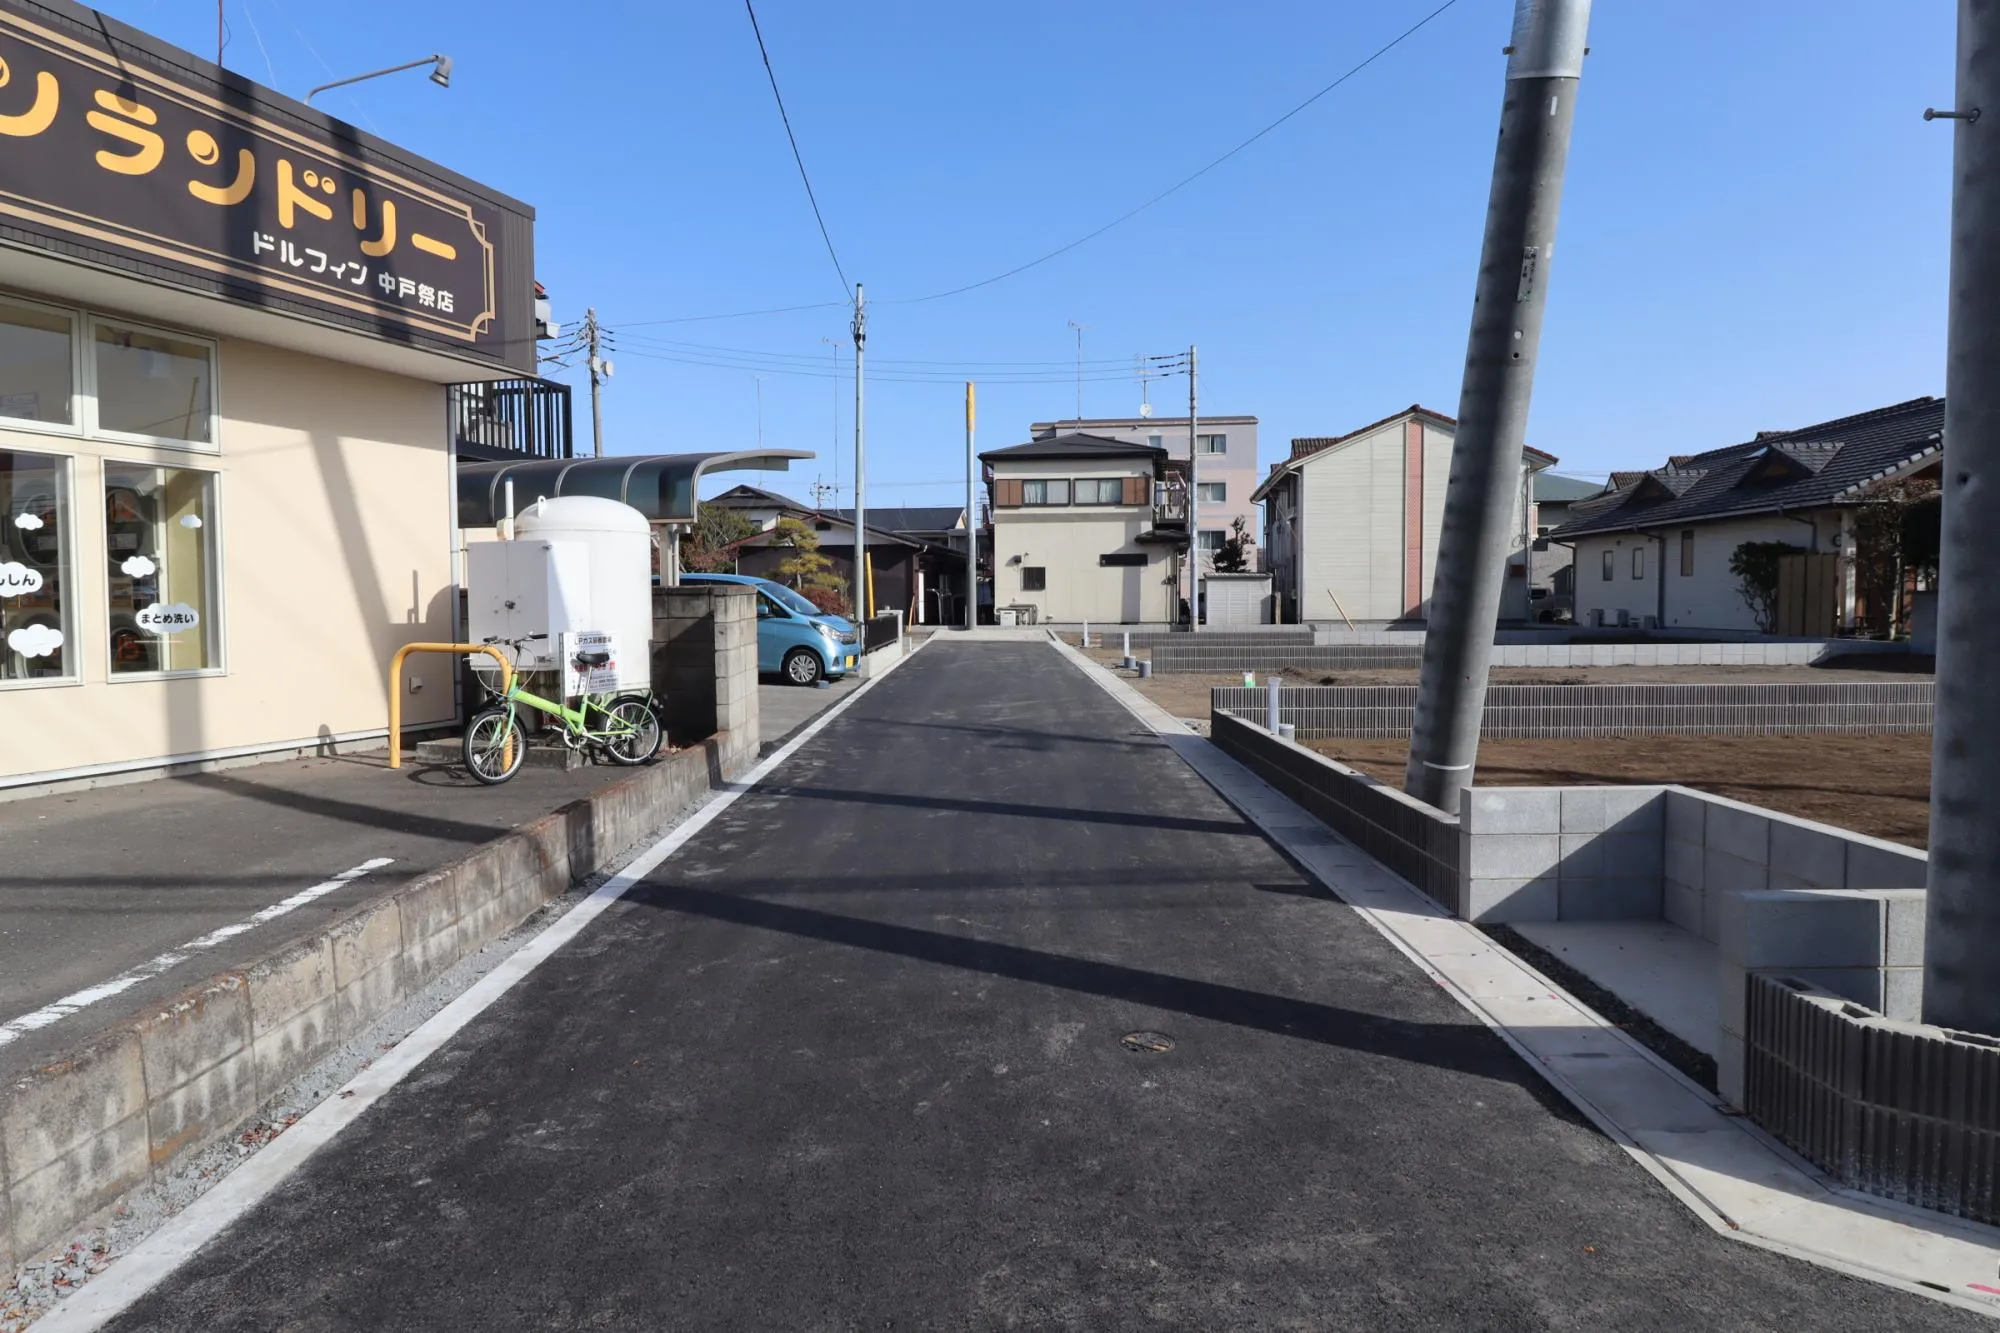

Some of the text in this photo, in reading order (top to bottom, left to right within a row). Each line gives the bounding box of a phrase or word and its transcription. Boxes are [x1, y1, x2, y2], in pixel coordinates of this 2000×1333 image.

[253, 231, 454, 313] ドルフィン 中戸祭店
[141, 613, 194, 624] まとめ洗い
